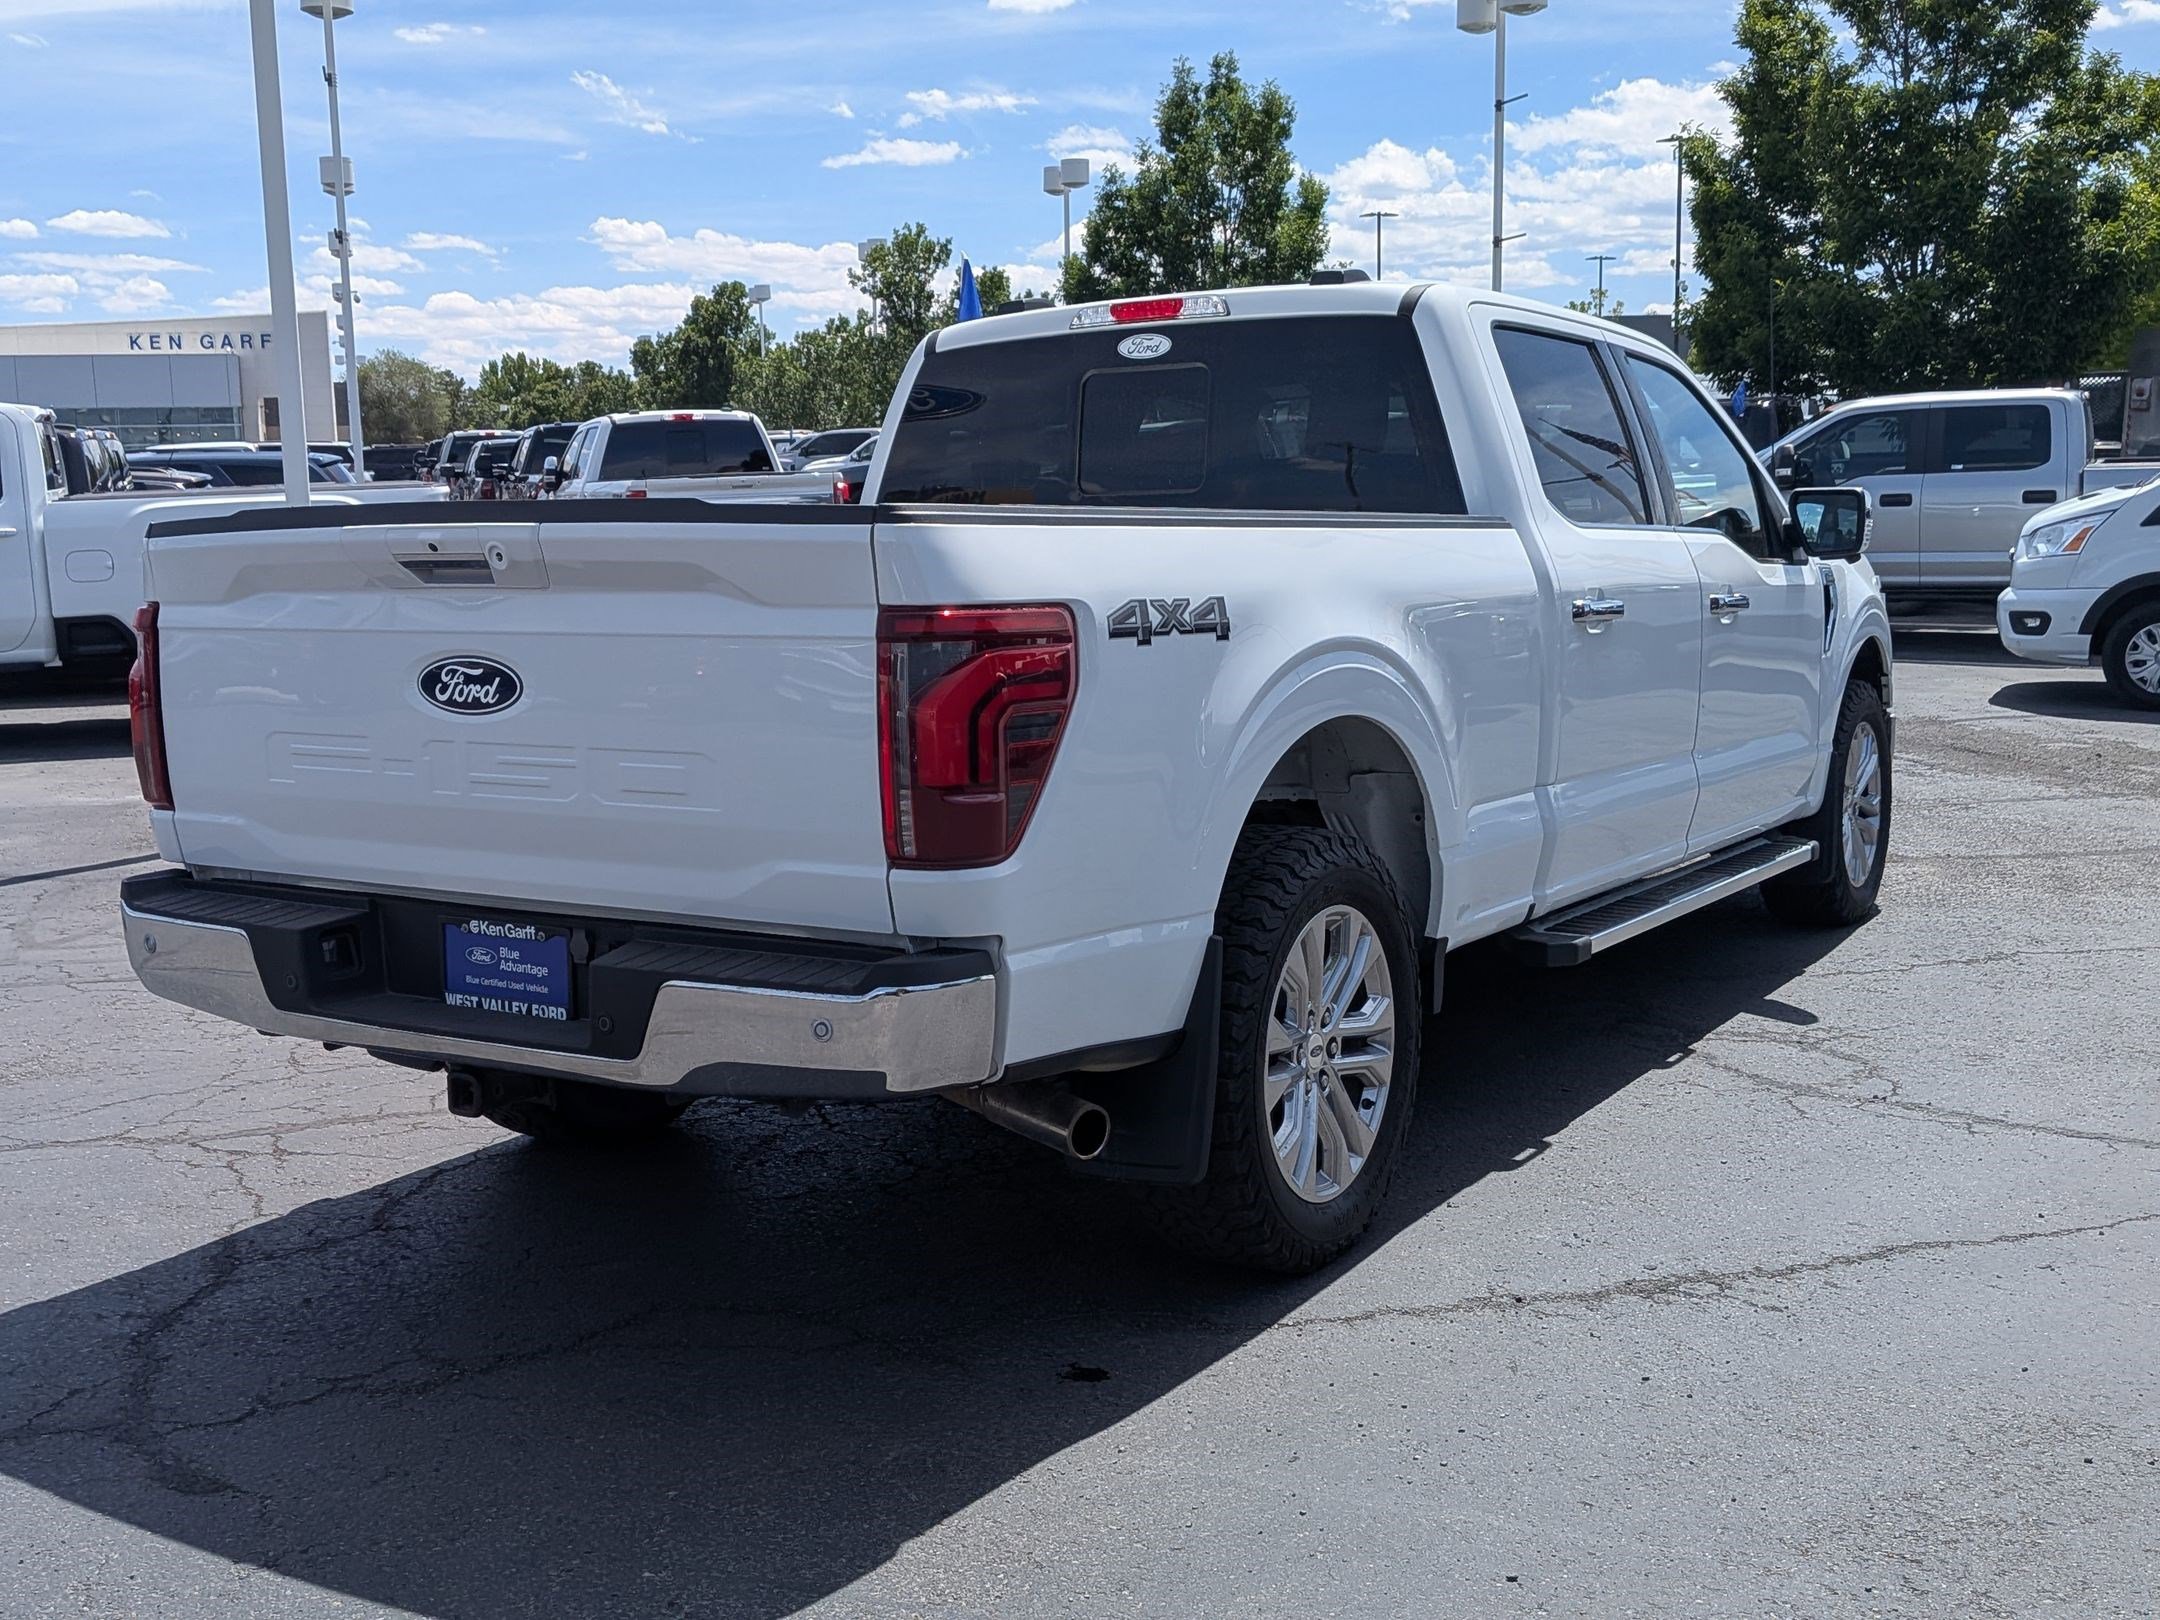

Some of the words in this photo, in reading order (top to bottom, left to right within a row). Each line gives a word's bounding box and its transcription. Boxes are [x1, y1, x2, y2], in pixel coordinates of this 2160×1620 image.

[129, 335, 182, 350] KEN
[1127, 337, 1162, 354] Ford
[1107, 596, 1230, 646] 4X4
[435, 665, 500, 704] Ford
[265, 730, 721, 812] F-150
[471, 948, 492, 962] Ford
[500, 947, 520, 960] Blue
[500, 960, 549, 977] Advantage
[465, 975, 480, 985] Blue
[480, 977, 507, 989] Certified
[508, 980, 525, 991] Used
[526, 983, 549, 994] Vehicle
[445, 992, 479, 1008] WEST
[482, 997, 528, 1016] VALLEY
[532, 1003, 567, 1020] FORD
